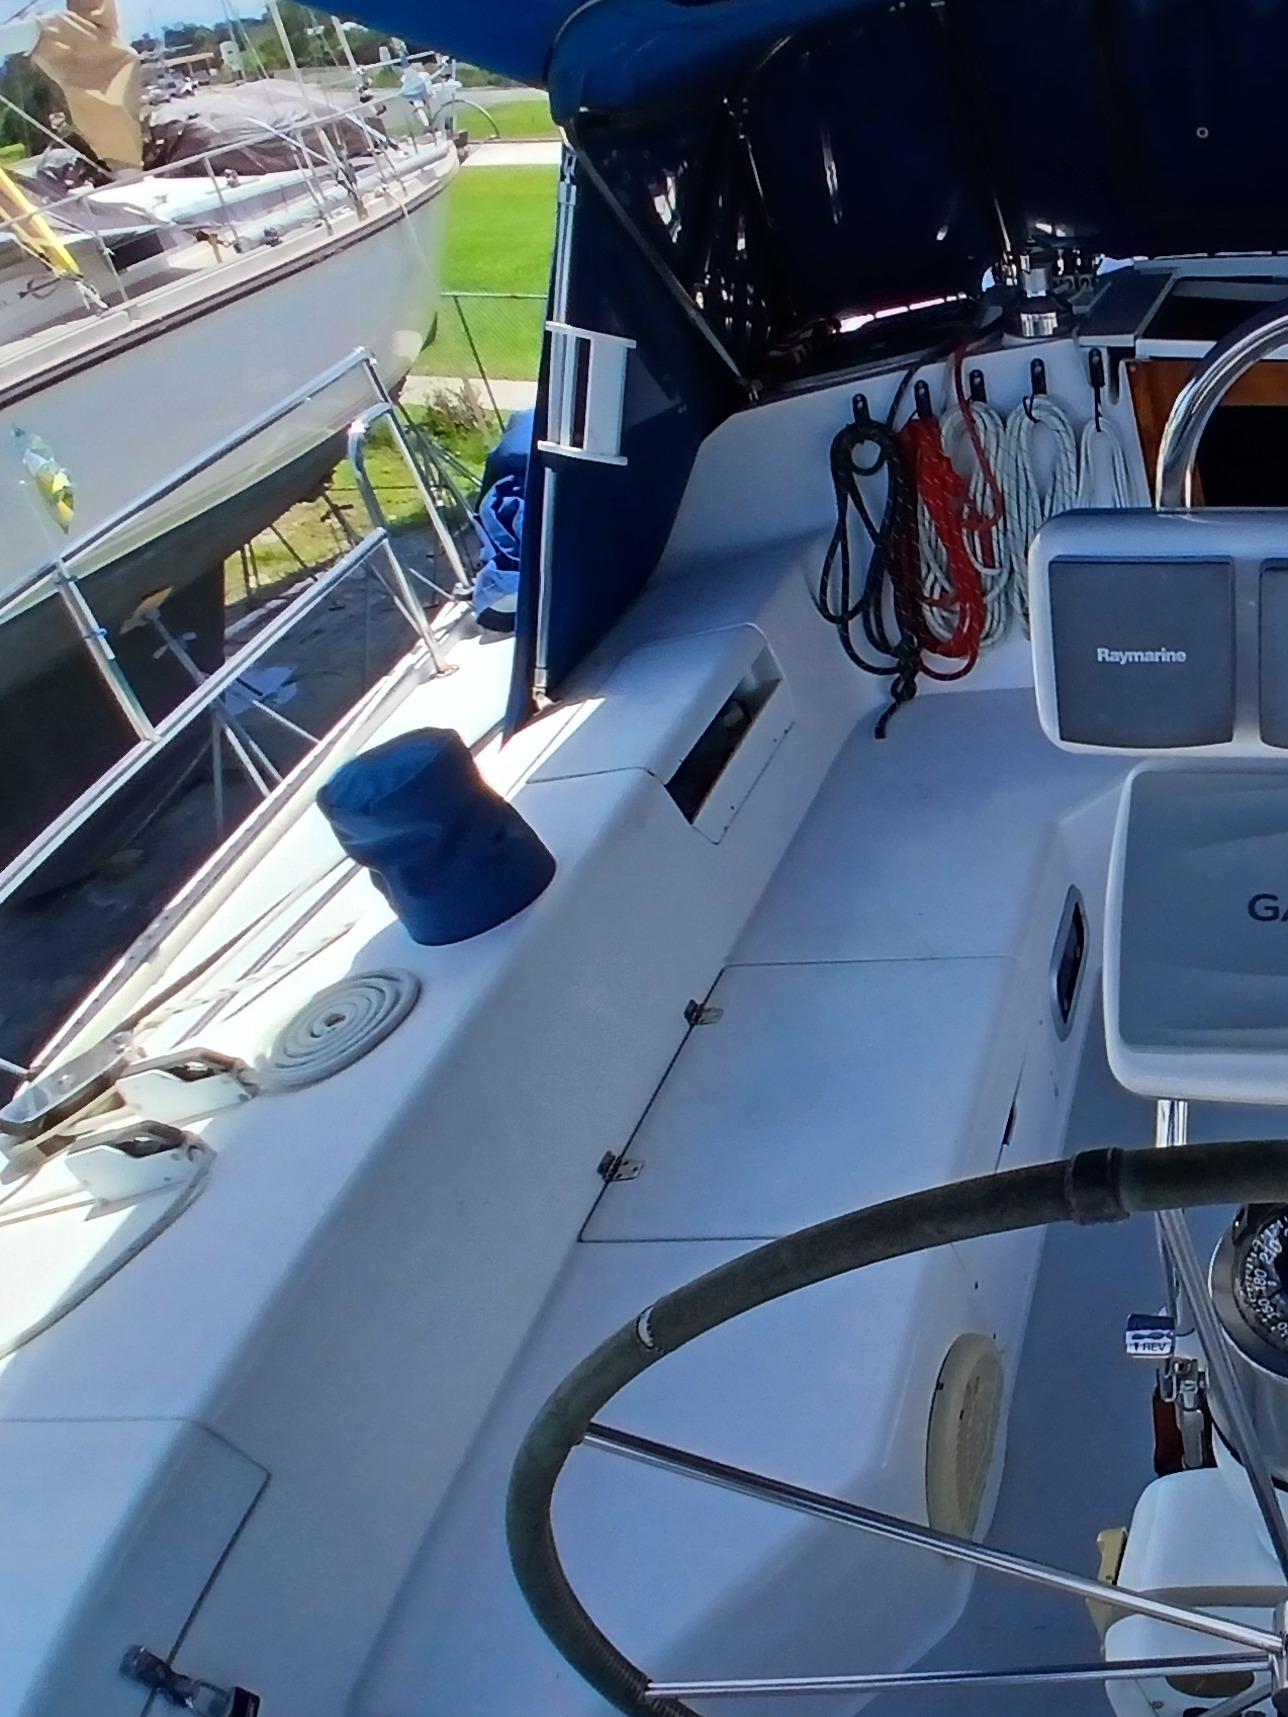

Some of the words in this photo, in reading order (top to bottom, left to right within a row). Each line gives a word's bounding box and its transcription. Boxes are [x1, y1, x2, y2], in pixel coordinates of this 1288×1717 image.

[1096, 647, 1187, 665] Raymarine
[1259, 1238, 1283, 1265] 210
[1253, 1268, 1267, 1291] 180
[1143, 1342, 1167, 1352] REV
